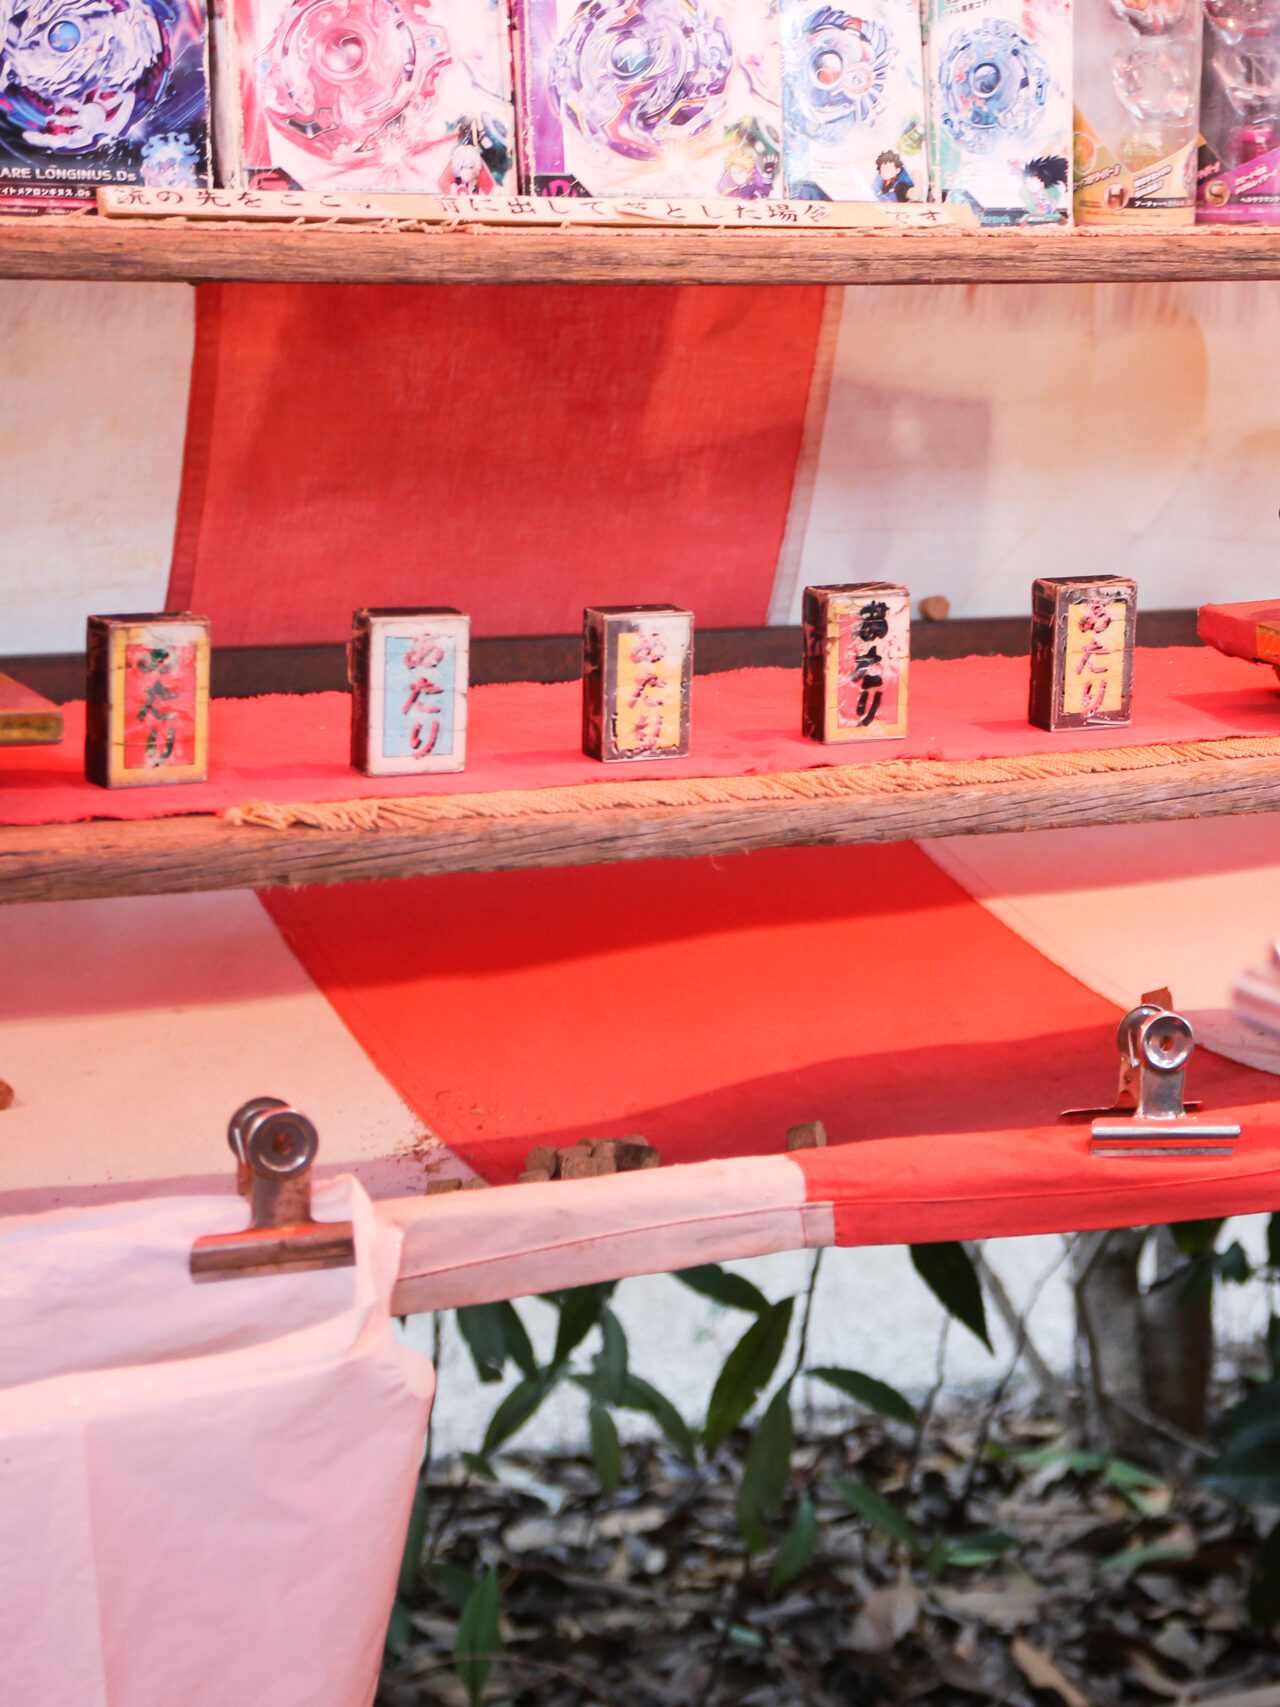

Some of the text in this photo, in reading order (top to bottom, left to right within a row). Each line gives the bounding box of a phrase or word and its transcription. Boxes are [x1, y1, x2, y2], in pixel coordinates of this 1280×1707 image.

[0, 187, 91, 198] イトメアロンギヌス.Ds
[402, 632, 444, 760] あたり
[1075, 600, 1112, 717] あたり
